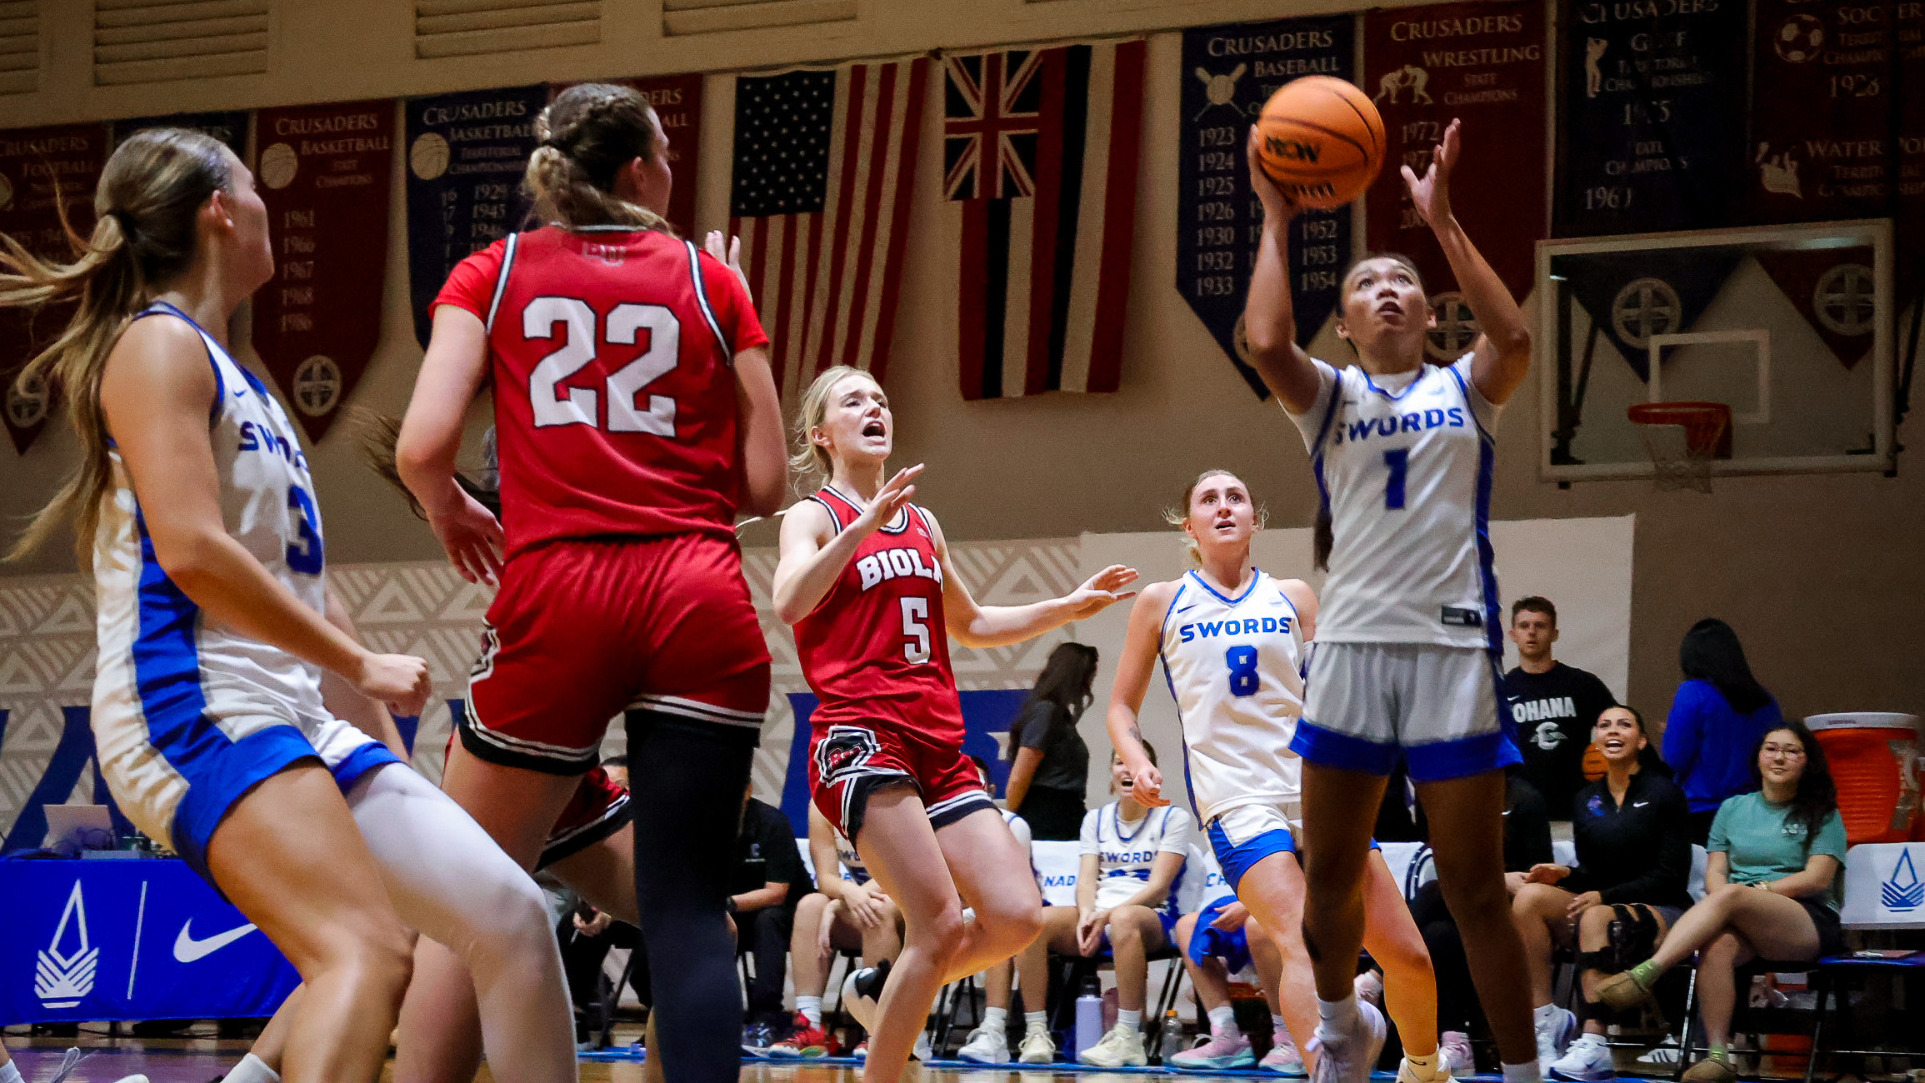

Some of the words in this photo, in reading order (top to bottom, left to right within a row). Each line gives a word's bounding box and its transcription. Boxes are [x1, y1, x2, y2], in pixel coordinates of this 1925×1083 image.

[1837, 2, 1924, 25] SOCER
[1390, 14, 1523, 42] CRUSADERS
[1207, 30, 1334, 57] CRUSADERS
[1254, 56, 1341, 78] BASEBALL
[1422, 45, 1541, 68] WRESTLING
[275, 113, 379, 136] CRUSADERS
[422, 101, 527, 126] CRUSADERS
[301, 135, 392, 156] BASKETBALL
[1200, 126, 1236, 147] 1923
[1199, 151, 1235, 172] 1924
[1198, 177, 1235, 198] 1925
[1197, 202, 1235, 222] 1926
[1196, 226, 1235, 247] 1930
[1302, 219, 1338, 241] 1952
[1196, 251, 1235, 272] 1932
[1302, 245, 1338, 266] 1953
[1195, 276, 1235, 297] 1933
[1301, 271, 1337, 291] 1954
[522, 295, 680, 437] 22
[1384, 447, 1409, 510] 1
[900, 596, 931, 665] 5
[1179, 616, 1293, 643] SWORDS
[1225, 645, 1260, 697] 8
[1099, 851, 1158, 864] SWORD
